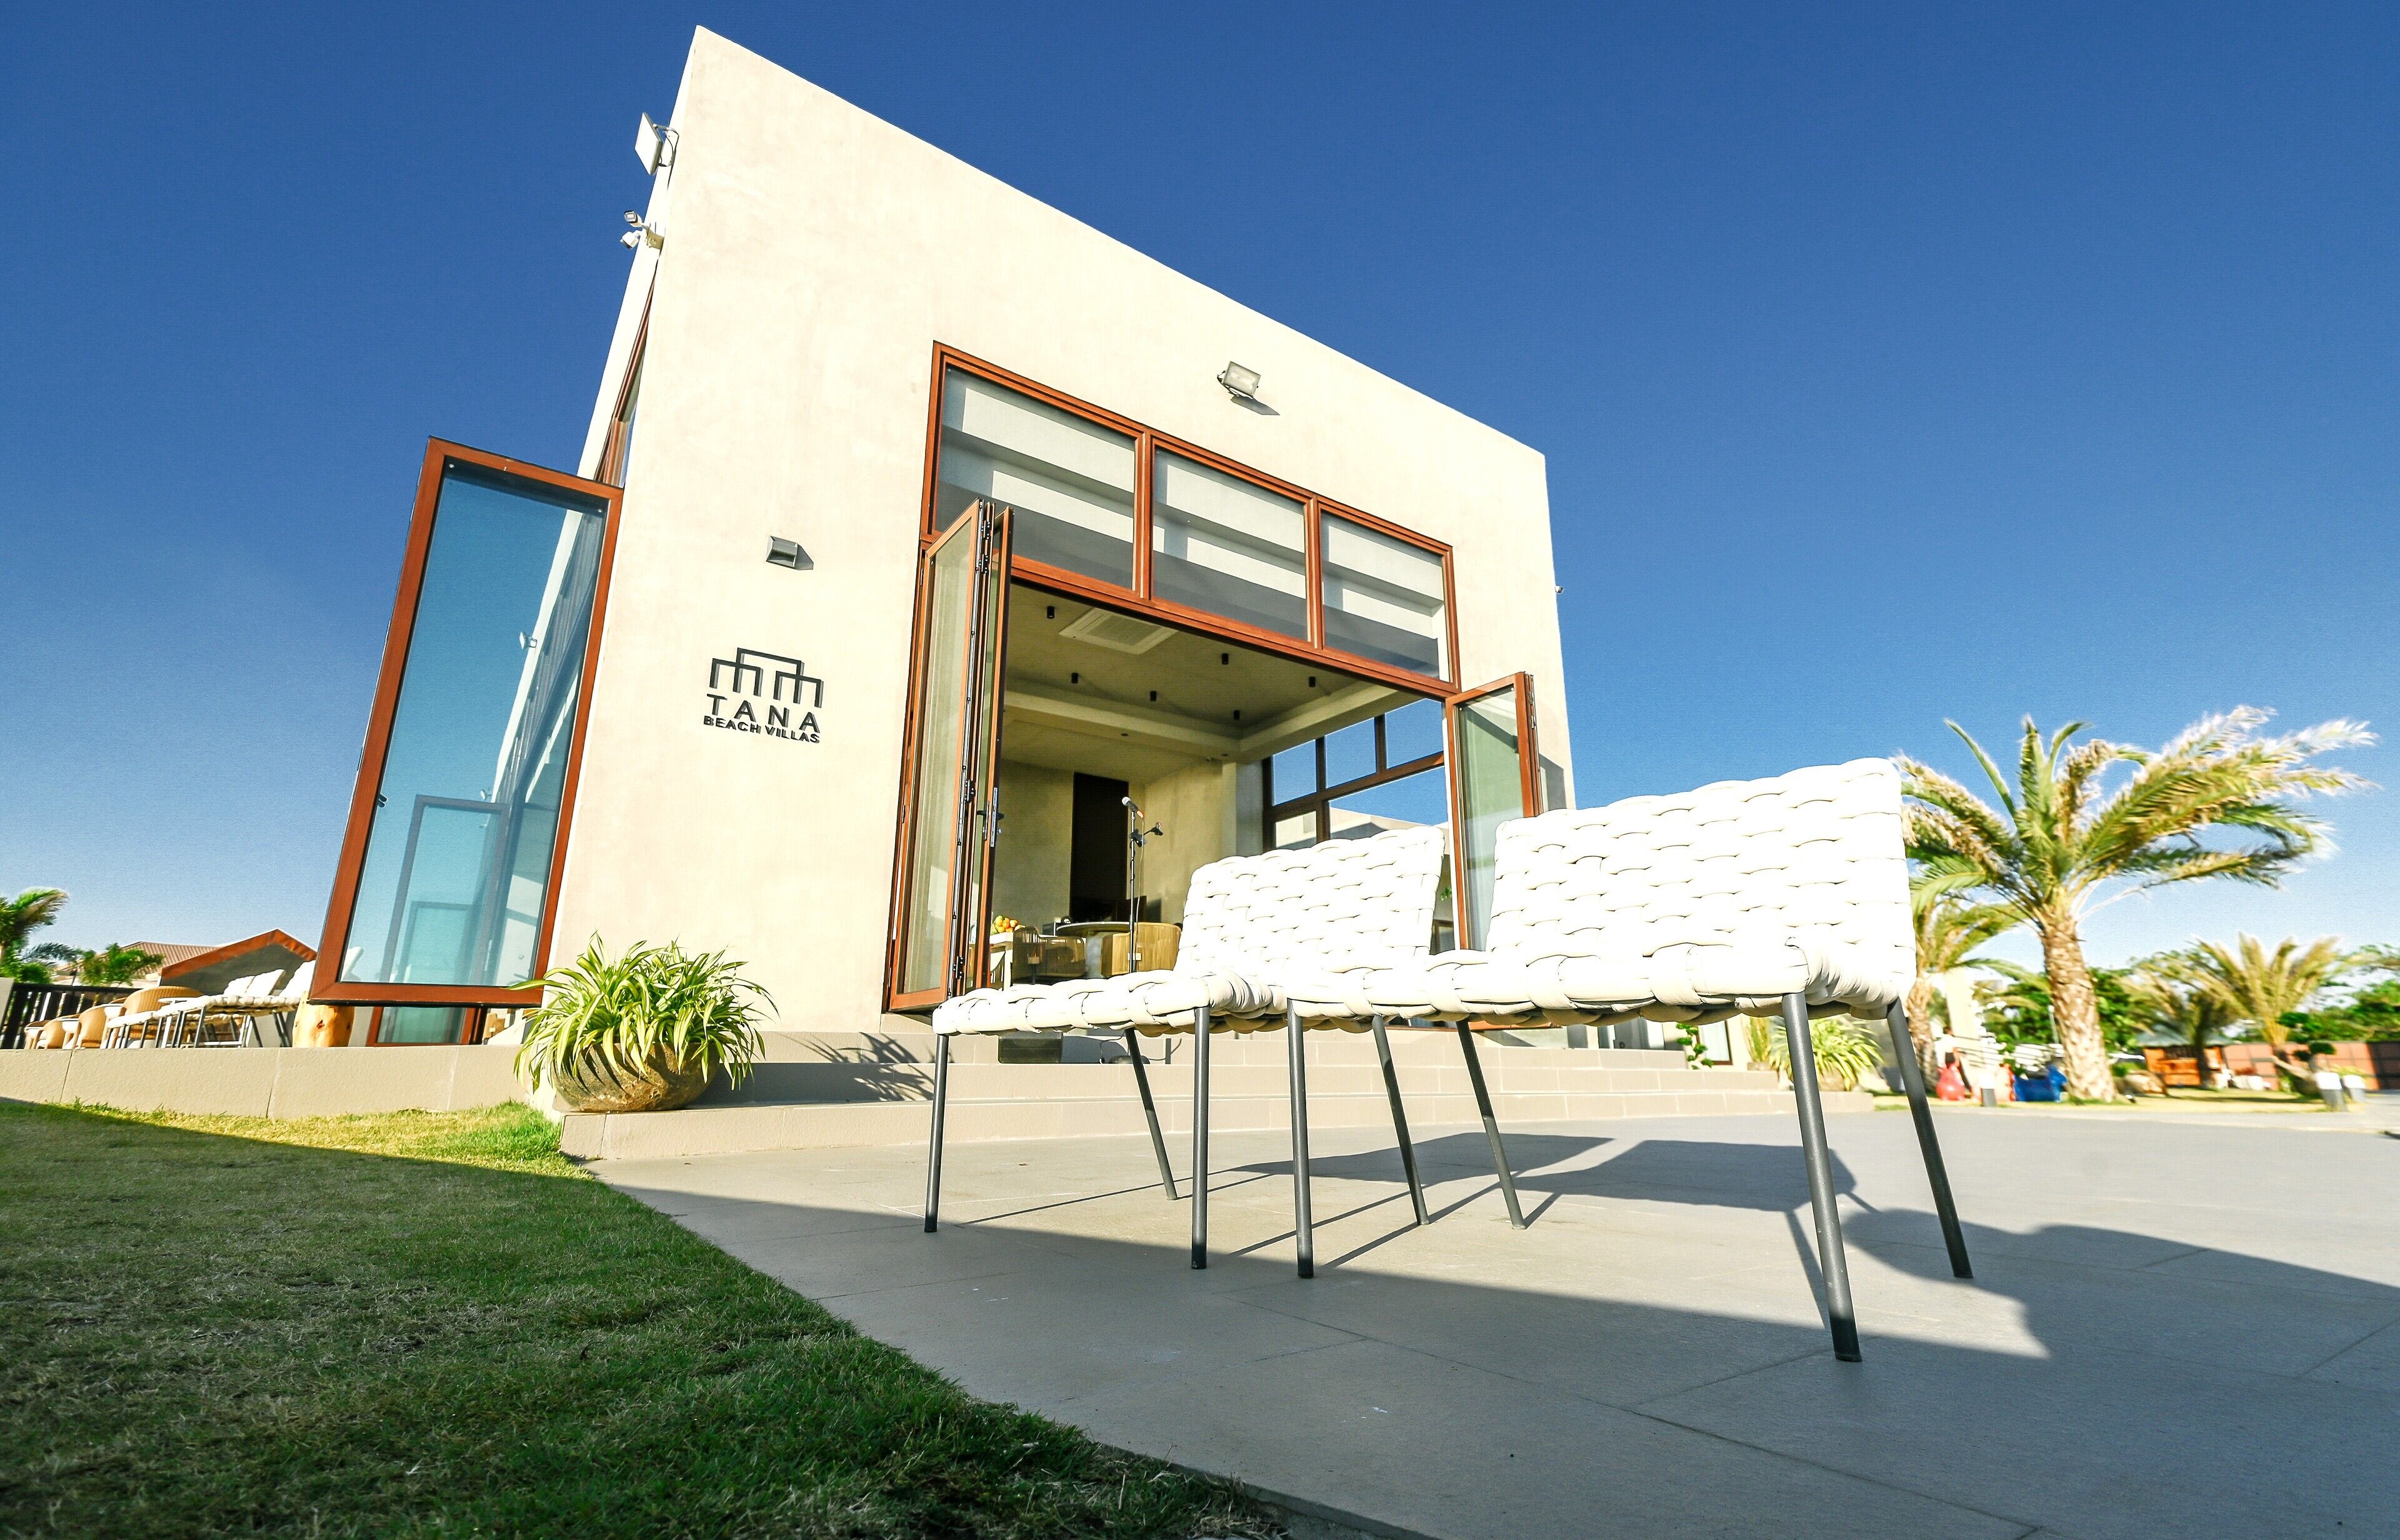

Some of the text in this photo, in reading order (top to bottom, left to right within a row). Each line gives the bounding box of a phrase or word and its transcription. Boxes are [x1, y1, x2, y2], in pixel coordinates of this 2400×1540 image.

[703, 716, 820, 743] BEACH VILLAS
[707, 694, 820, 733] TANA
